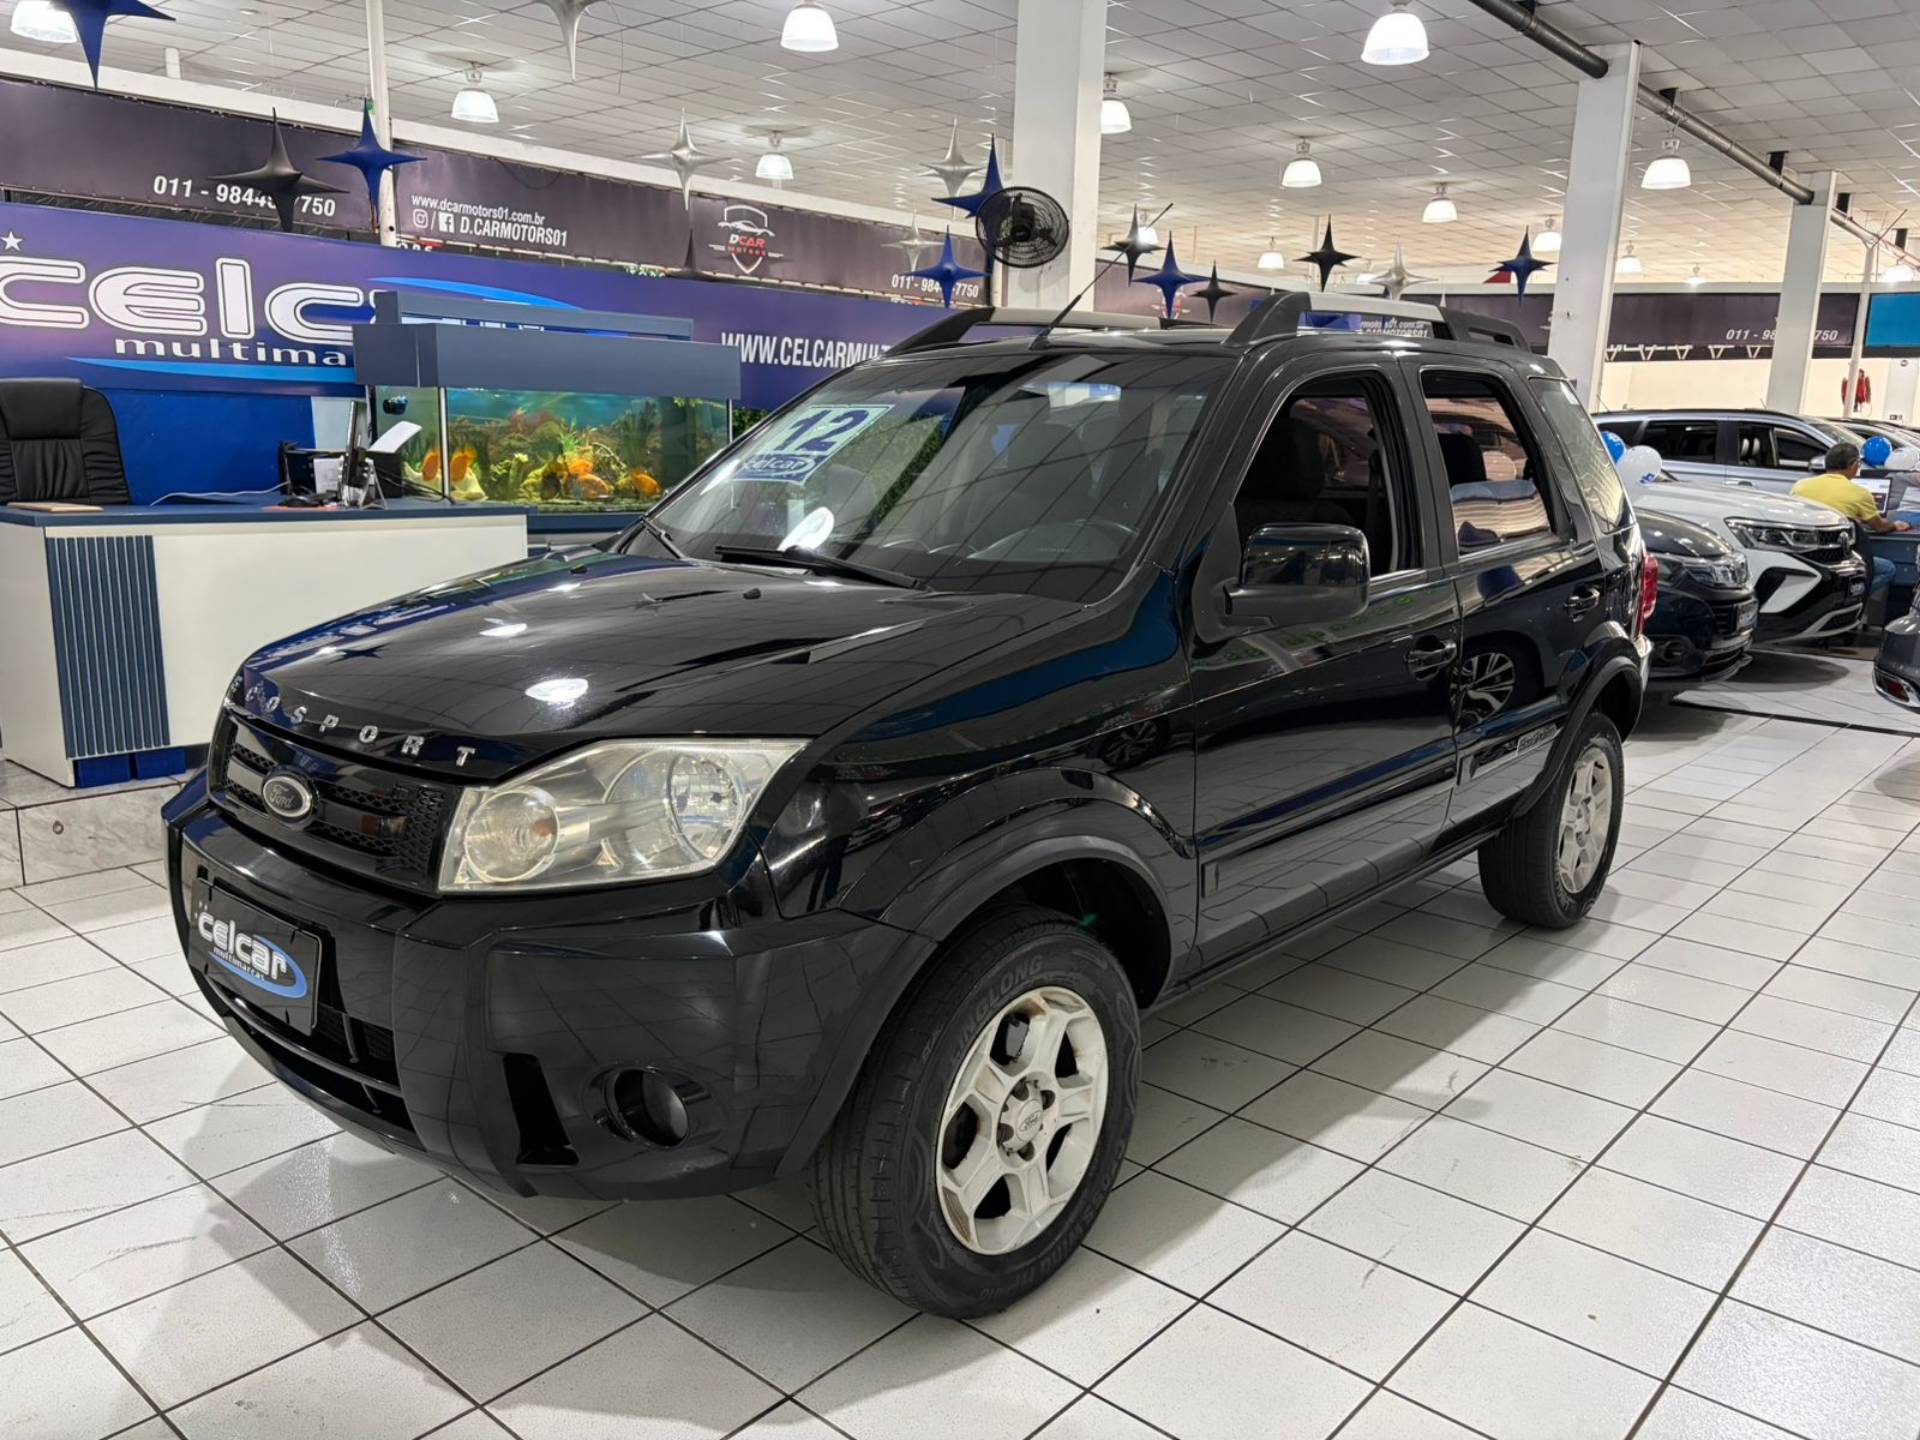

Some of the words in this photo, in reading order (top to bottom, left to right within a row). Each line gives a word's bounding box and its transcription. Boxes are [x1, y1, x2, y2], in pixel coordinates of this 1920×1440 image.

[153, 176, 193, 198] 011
[411, 195, 546, 226] www.dcarmotors01.com.br
[459, 216, 568, 247] D.CARMOTORS01
[729, 233, 766, 248] DCAR
[891, 274, 911, 289] 011
[1726, 329, 1749, 341] 011
[773, 409, 870, 452] 12
[198, 911, 287, 980] celcar
